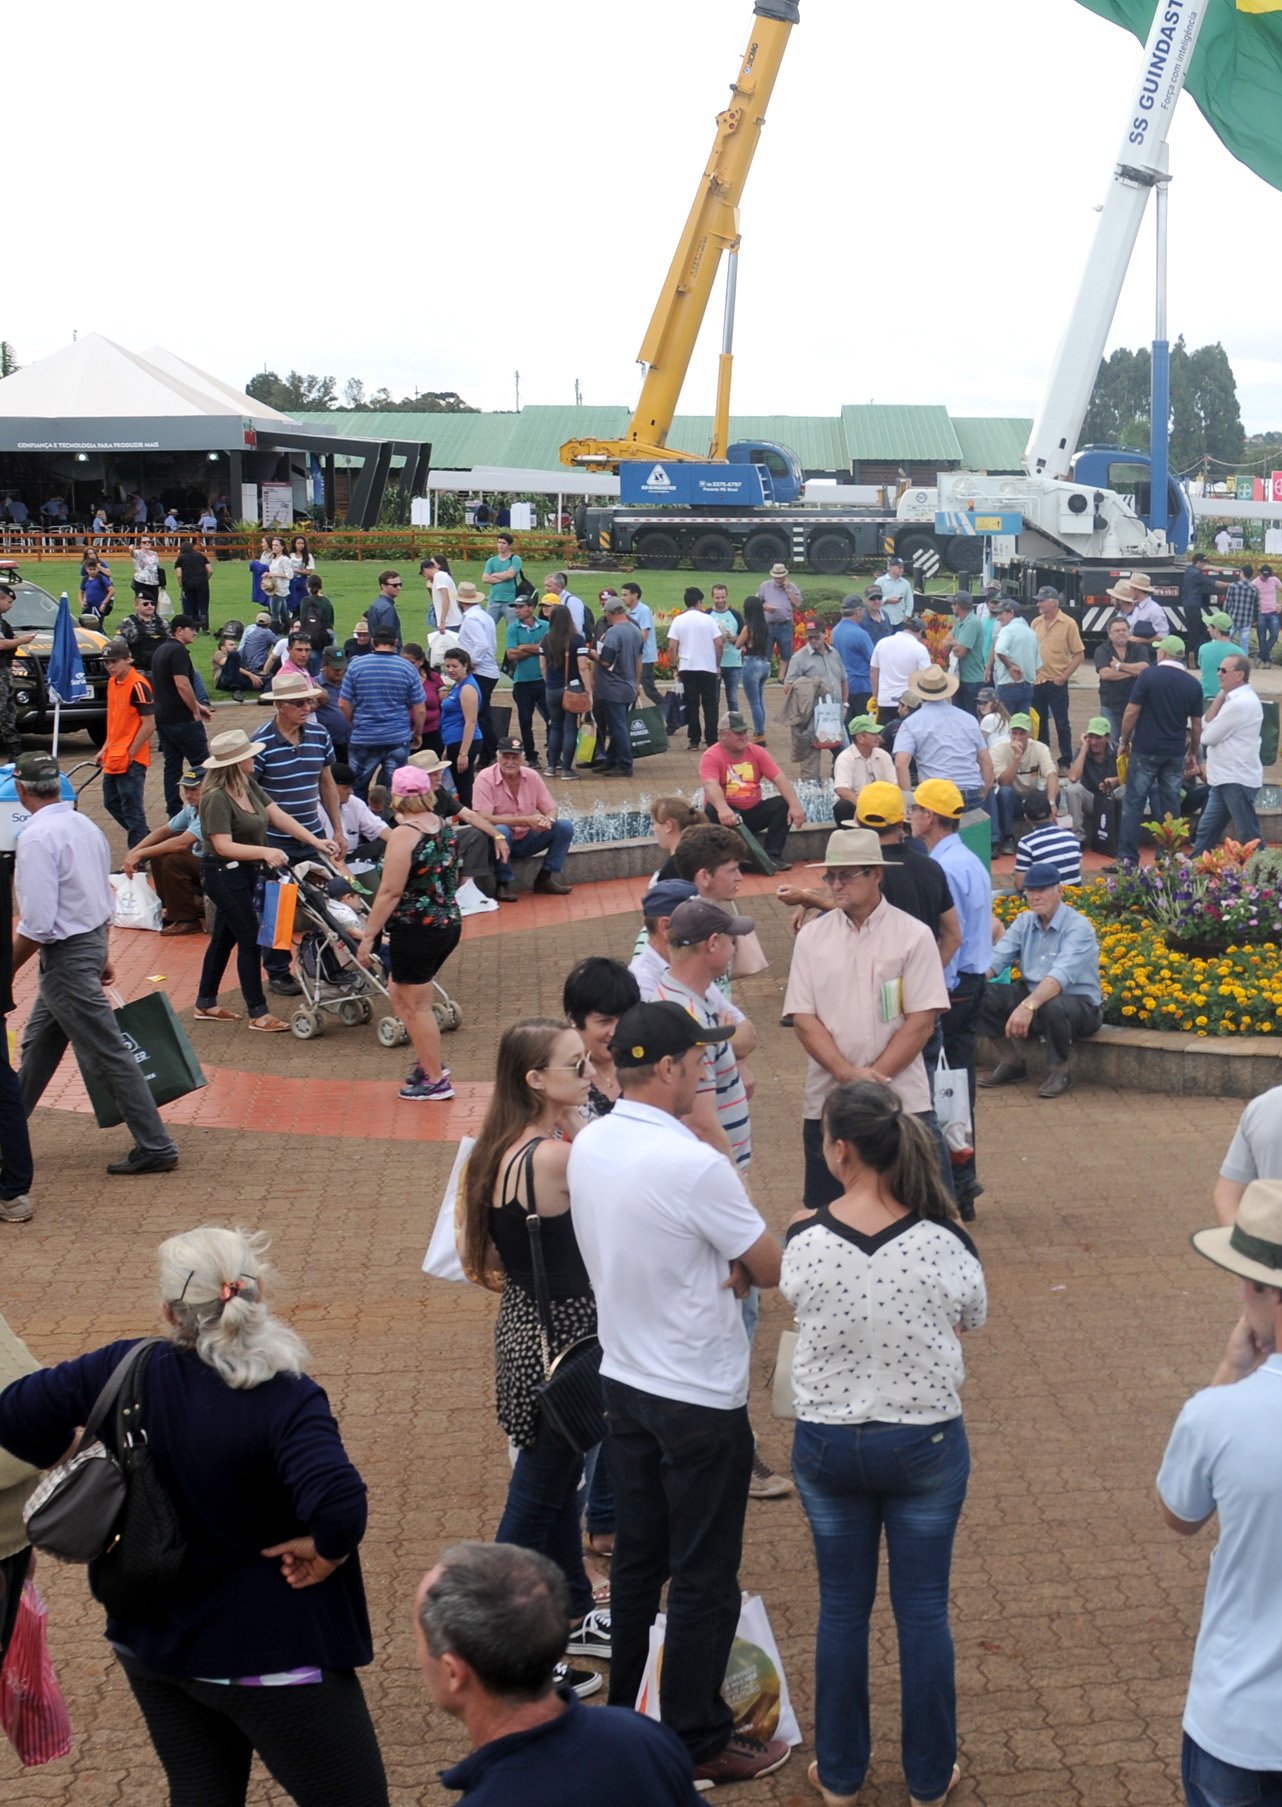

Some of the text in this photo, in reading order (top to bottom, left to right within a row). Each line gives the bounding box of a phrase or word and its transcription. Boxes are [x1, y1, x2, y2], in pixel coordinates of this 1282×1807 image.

[1161, 11, 1198, 110] Força com inteligência
[1129, 117, 1149, 146] SS
